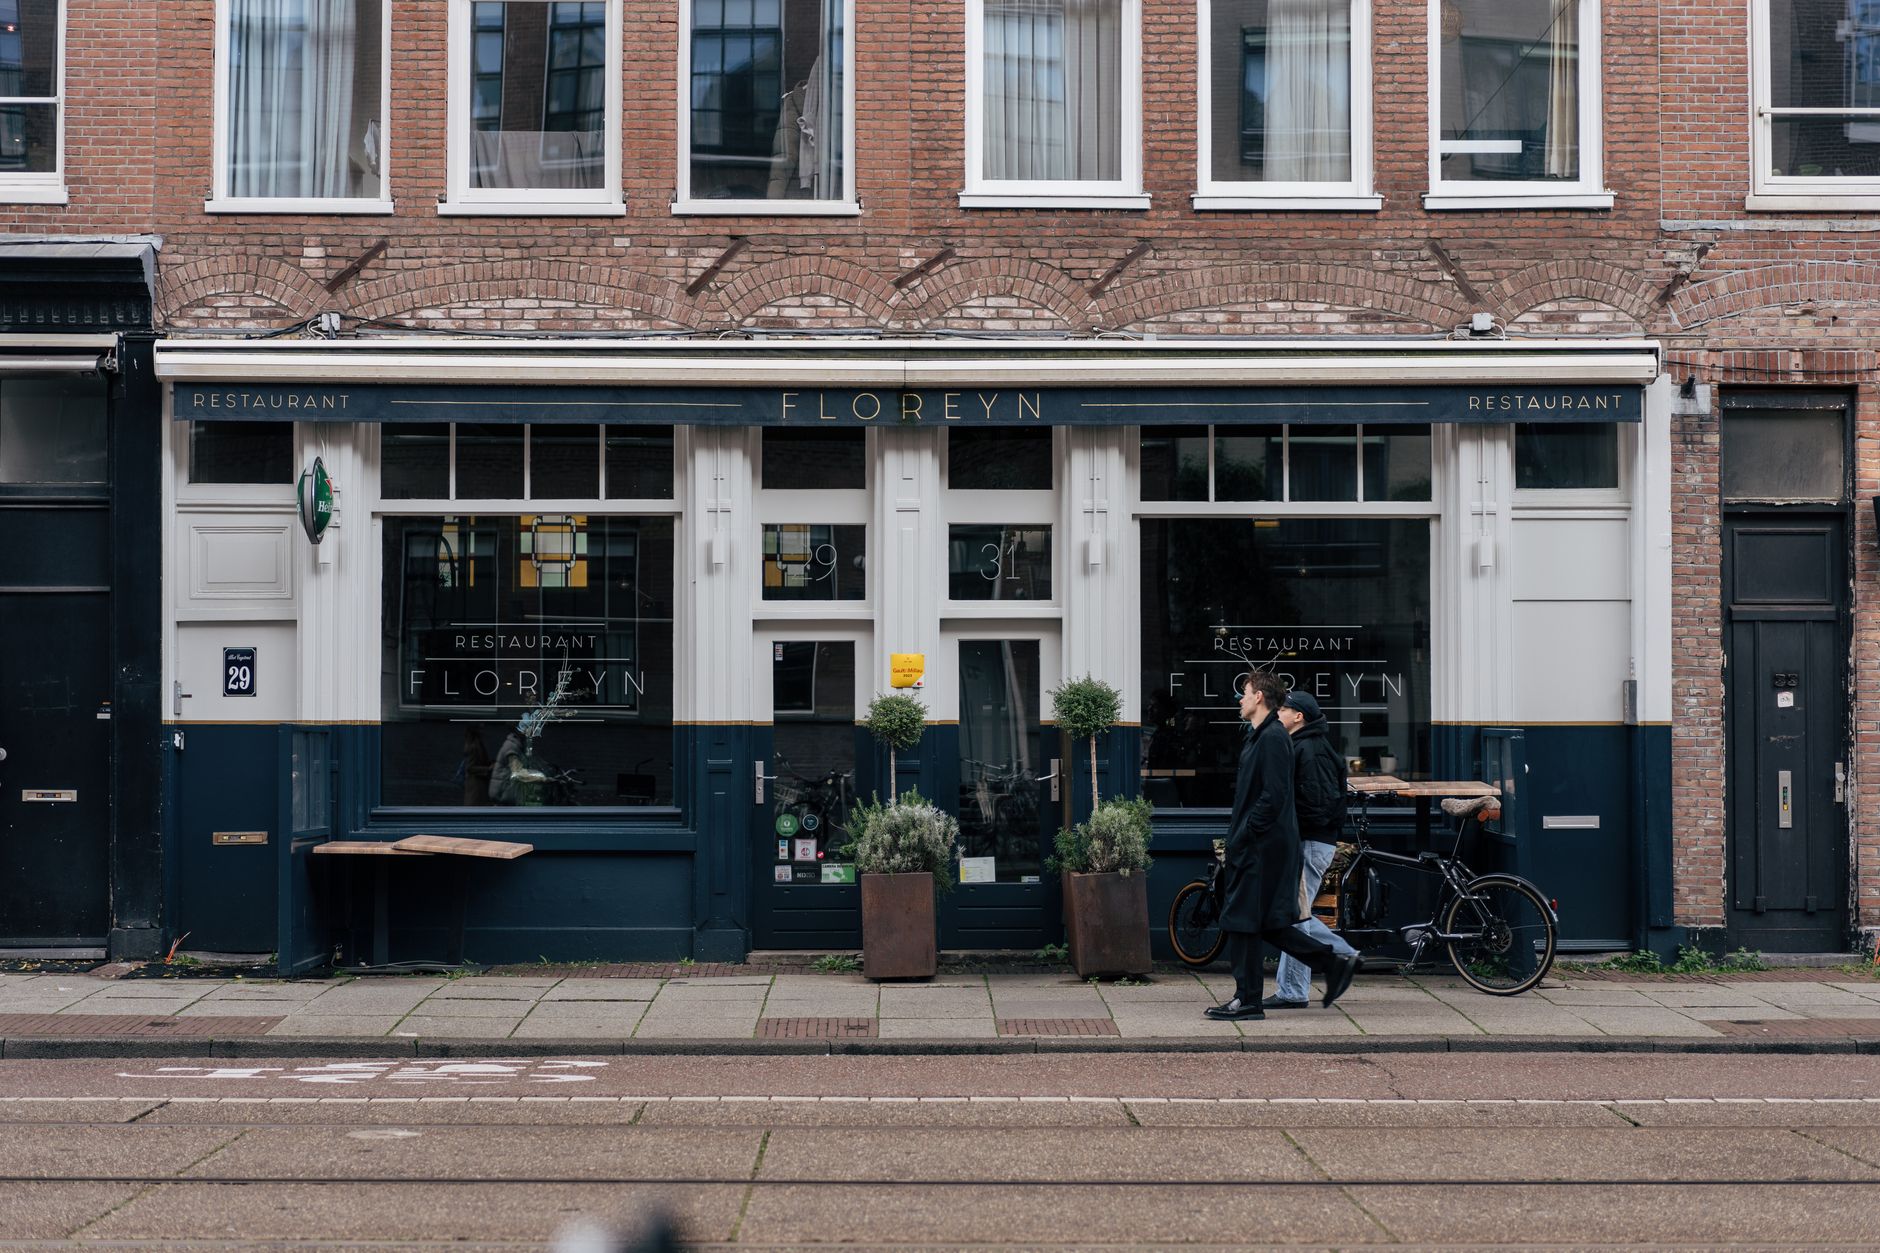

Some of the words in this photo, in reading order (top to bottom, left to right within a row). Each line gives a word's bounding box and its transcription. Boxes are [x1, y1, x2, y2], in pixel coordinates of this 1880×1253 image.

[193, 393, 349, 409] RESTAURANT
[782, 393, 1040, 420] FLOREYN
[1469, 394, 1622, 410] RESTAURANT
[791, 543, 837, 581] 29
[980, 543, 1021, 580] 31
[455, 635, 597, 649] RESTAURANT
[1213, 637, 1354, 651] RESTAURANT
[228, 666, 251, 690] 29
[410, 670, 645, 696] FLOREYN
